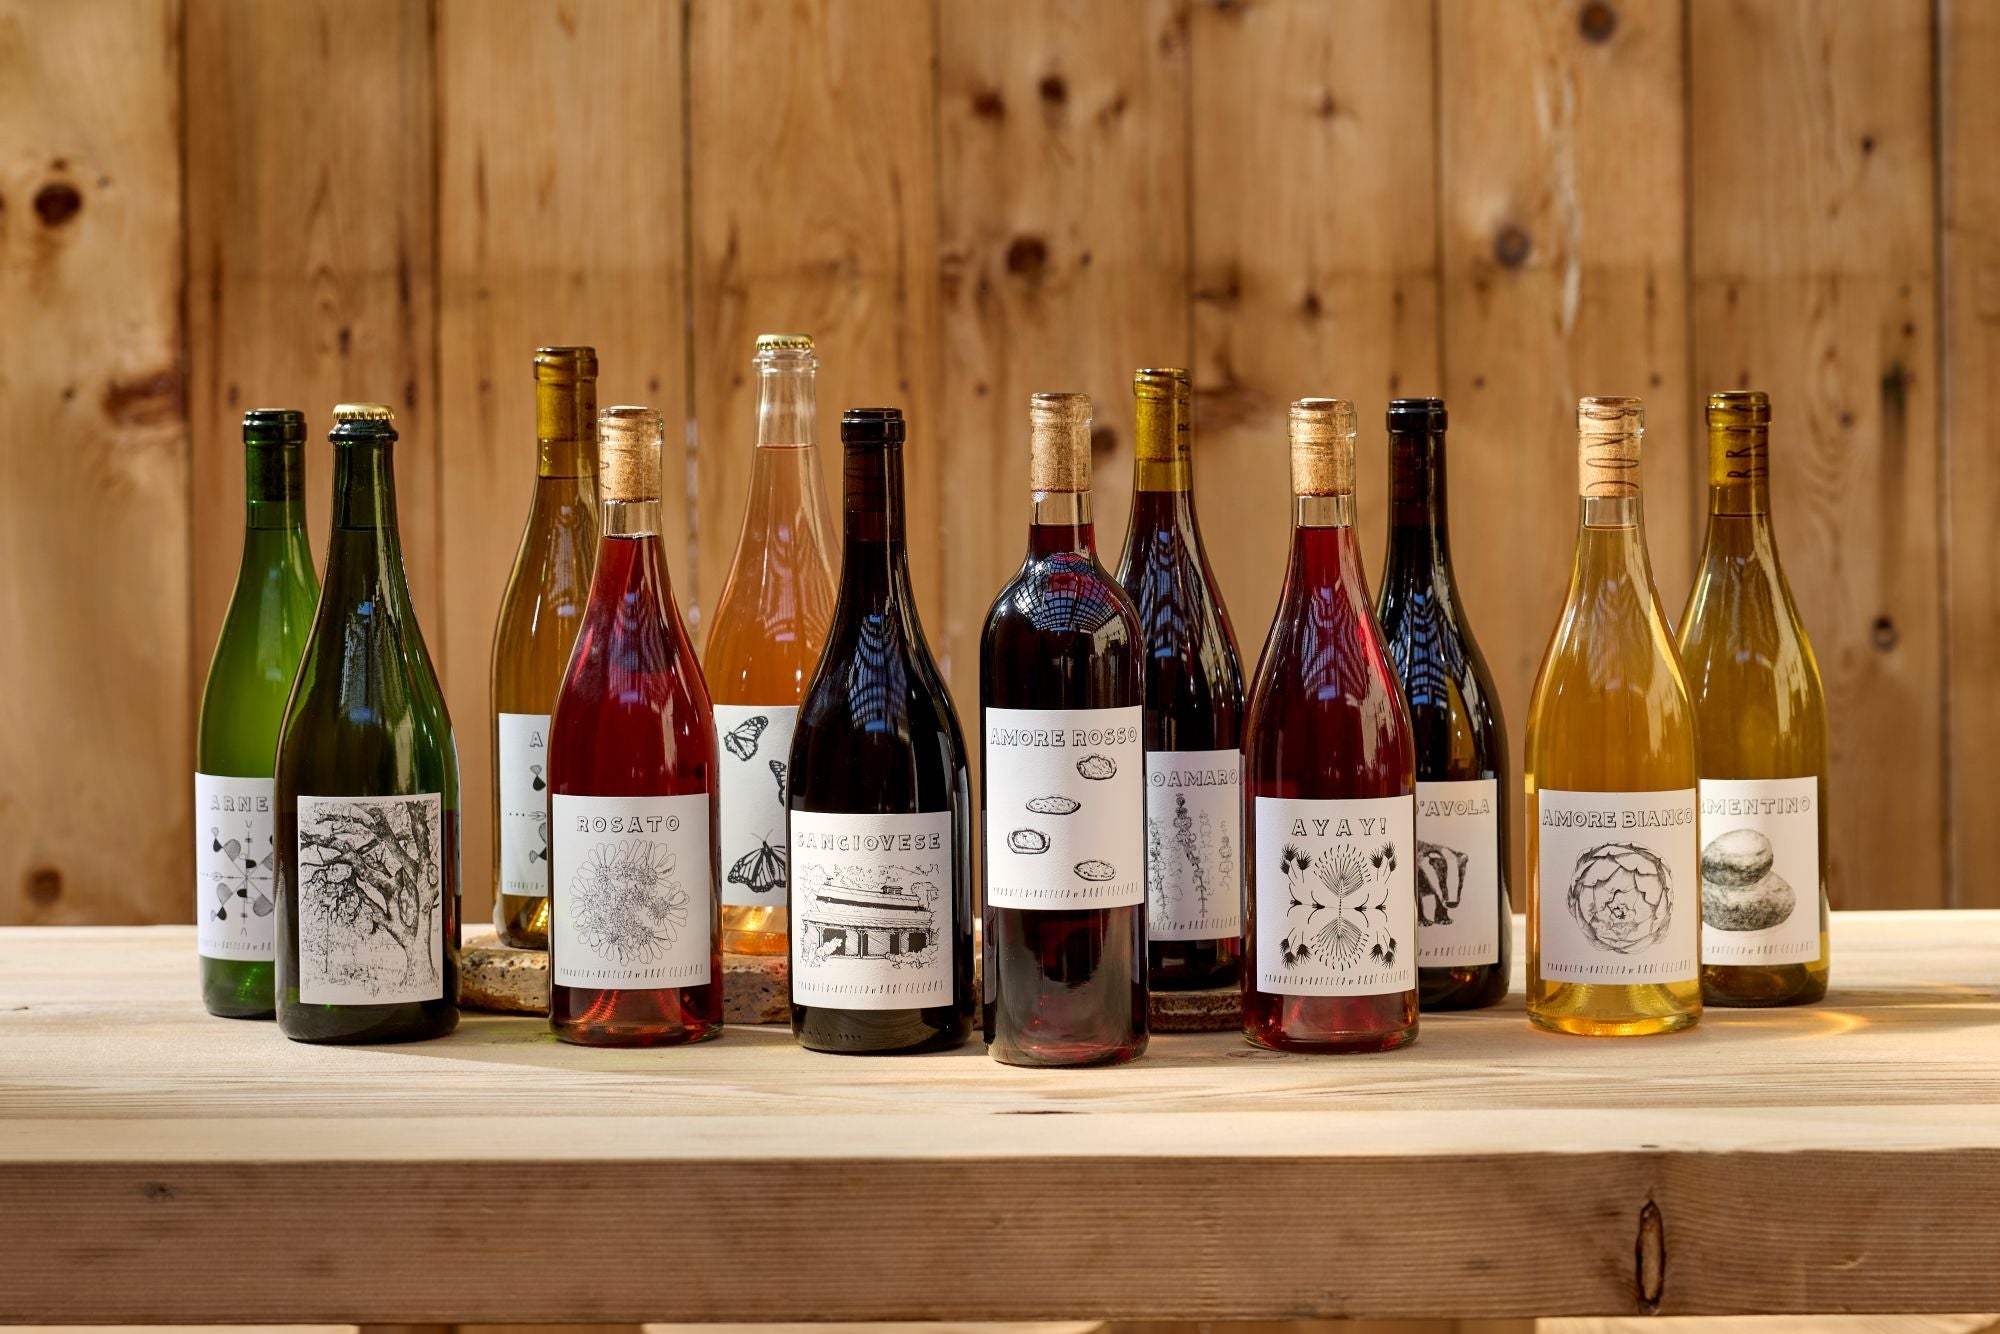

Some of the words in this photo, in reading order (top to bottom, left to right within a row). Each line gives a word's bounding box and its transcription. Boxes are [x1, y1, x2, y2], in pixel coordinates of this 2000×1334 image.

[990, 728, 1065, 747] AMORE
[1072, 727, 1137, 746] ROSSO
[576, 815, 680, 833] ROSATO
[1291, 817, 1387, 836] AYAY!
[1542, 809, 1616, 828] AMORE
[1622, 808, 1693, 828] BIANCO
[797, 832, 941, 851] SANGIOVESE
